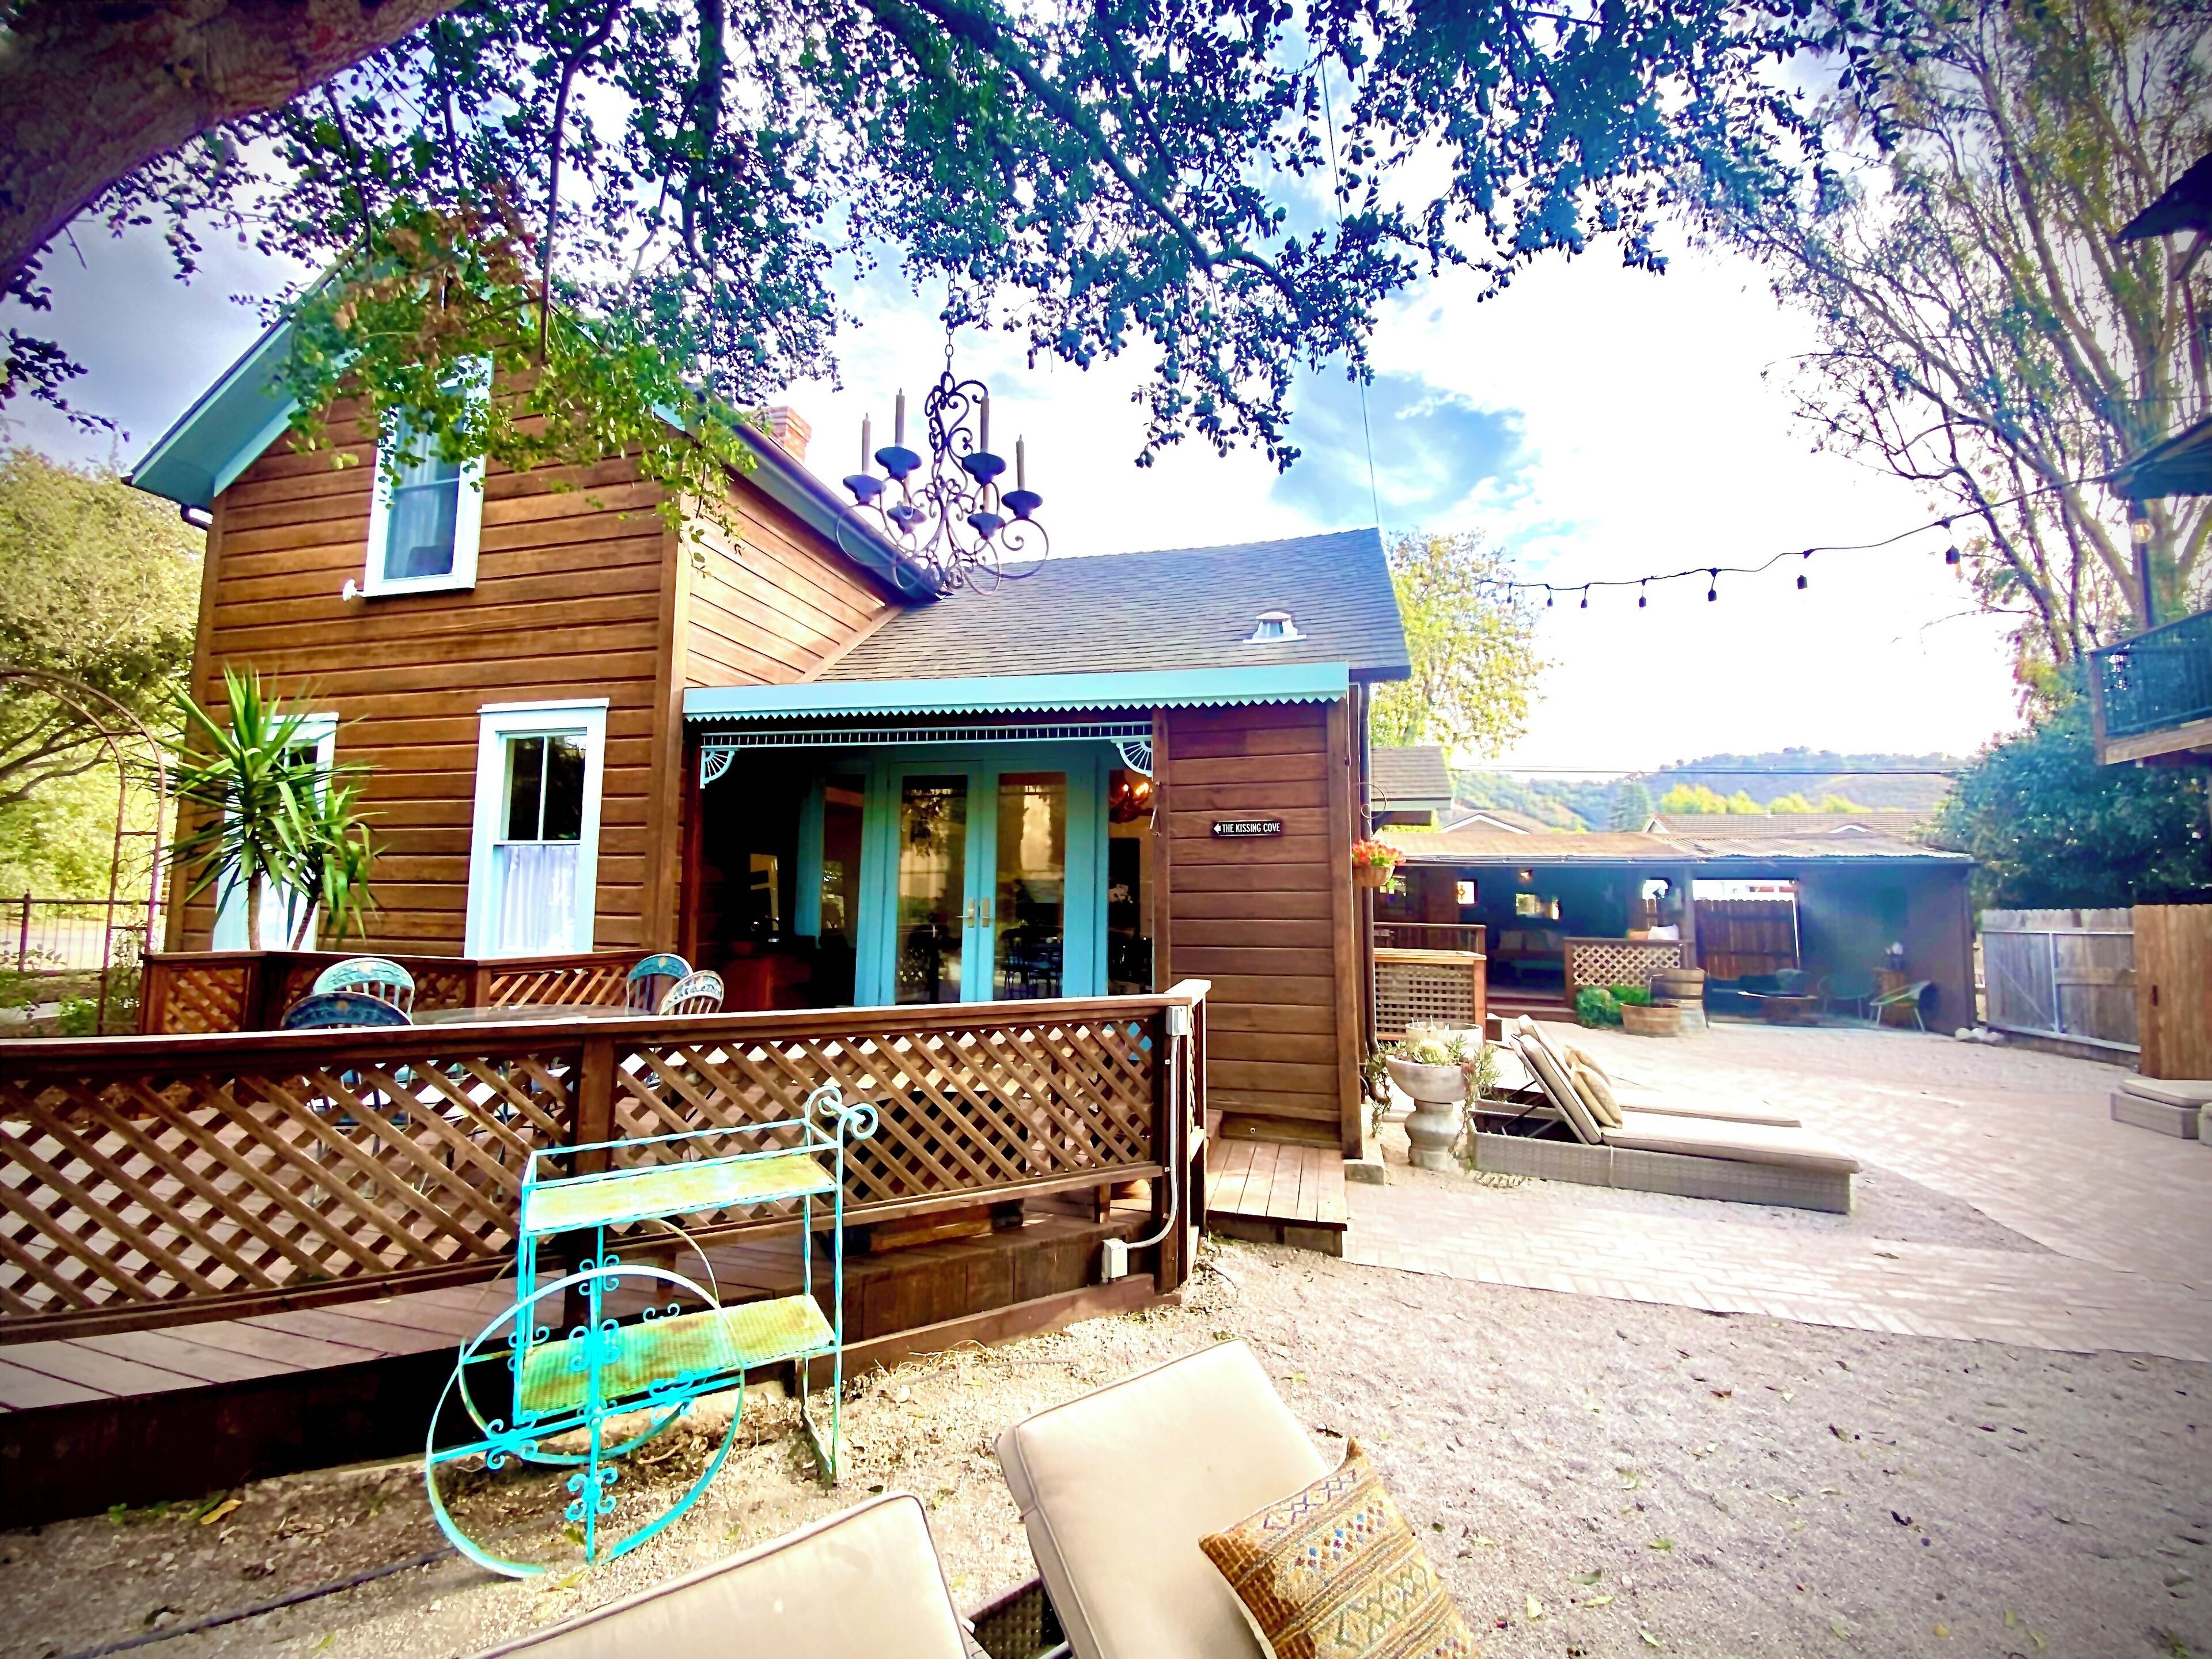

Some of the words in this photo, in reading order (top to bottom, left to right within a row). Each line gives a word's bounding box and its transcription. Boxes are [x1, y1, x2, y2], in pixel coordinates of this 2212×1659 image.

[1222, 824, 1234, 833] THE
[1236, 823, 1262, 832] KISSING
[1263, 823, 1281, 832] COVE
